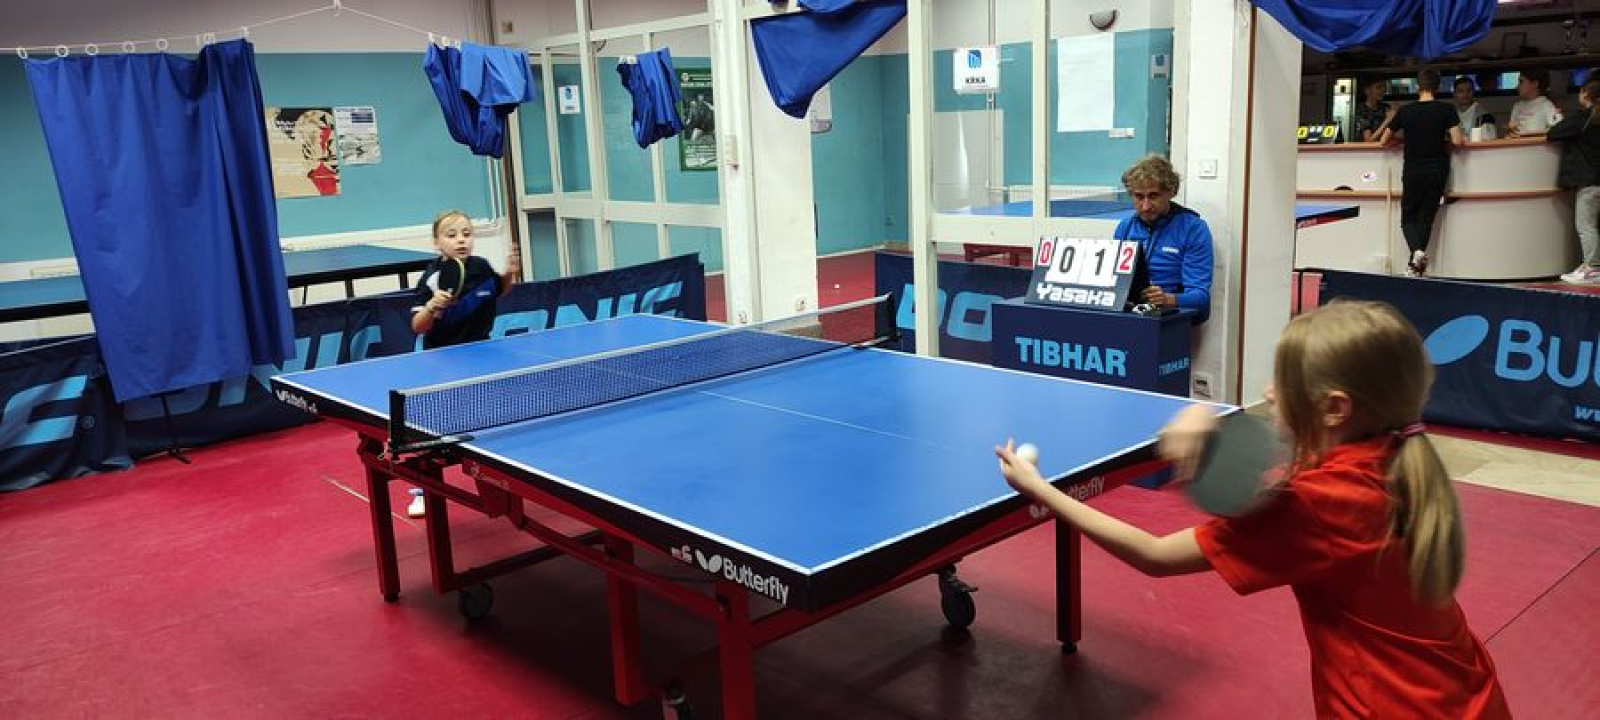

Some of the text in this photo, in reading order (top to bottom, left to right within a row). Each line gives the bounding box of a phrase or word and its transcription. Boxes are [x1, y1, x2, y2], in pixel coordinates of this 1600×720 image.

[1039, 241, 1134, 275] 0 0 1 2
[1015, 336, 1127, 377] TIBHAR
[723, 557, 789, 606] Butterfly
